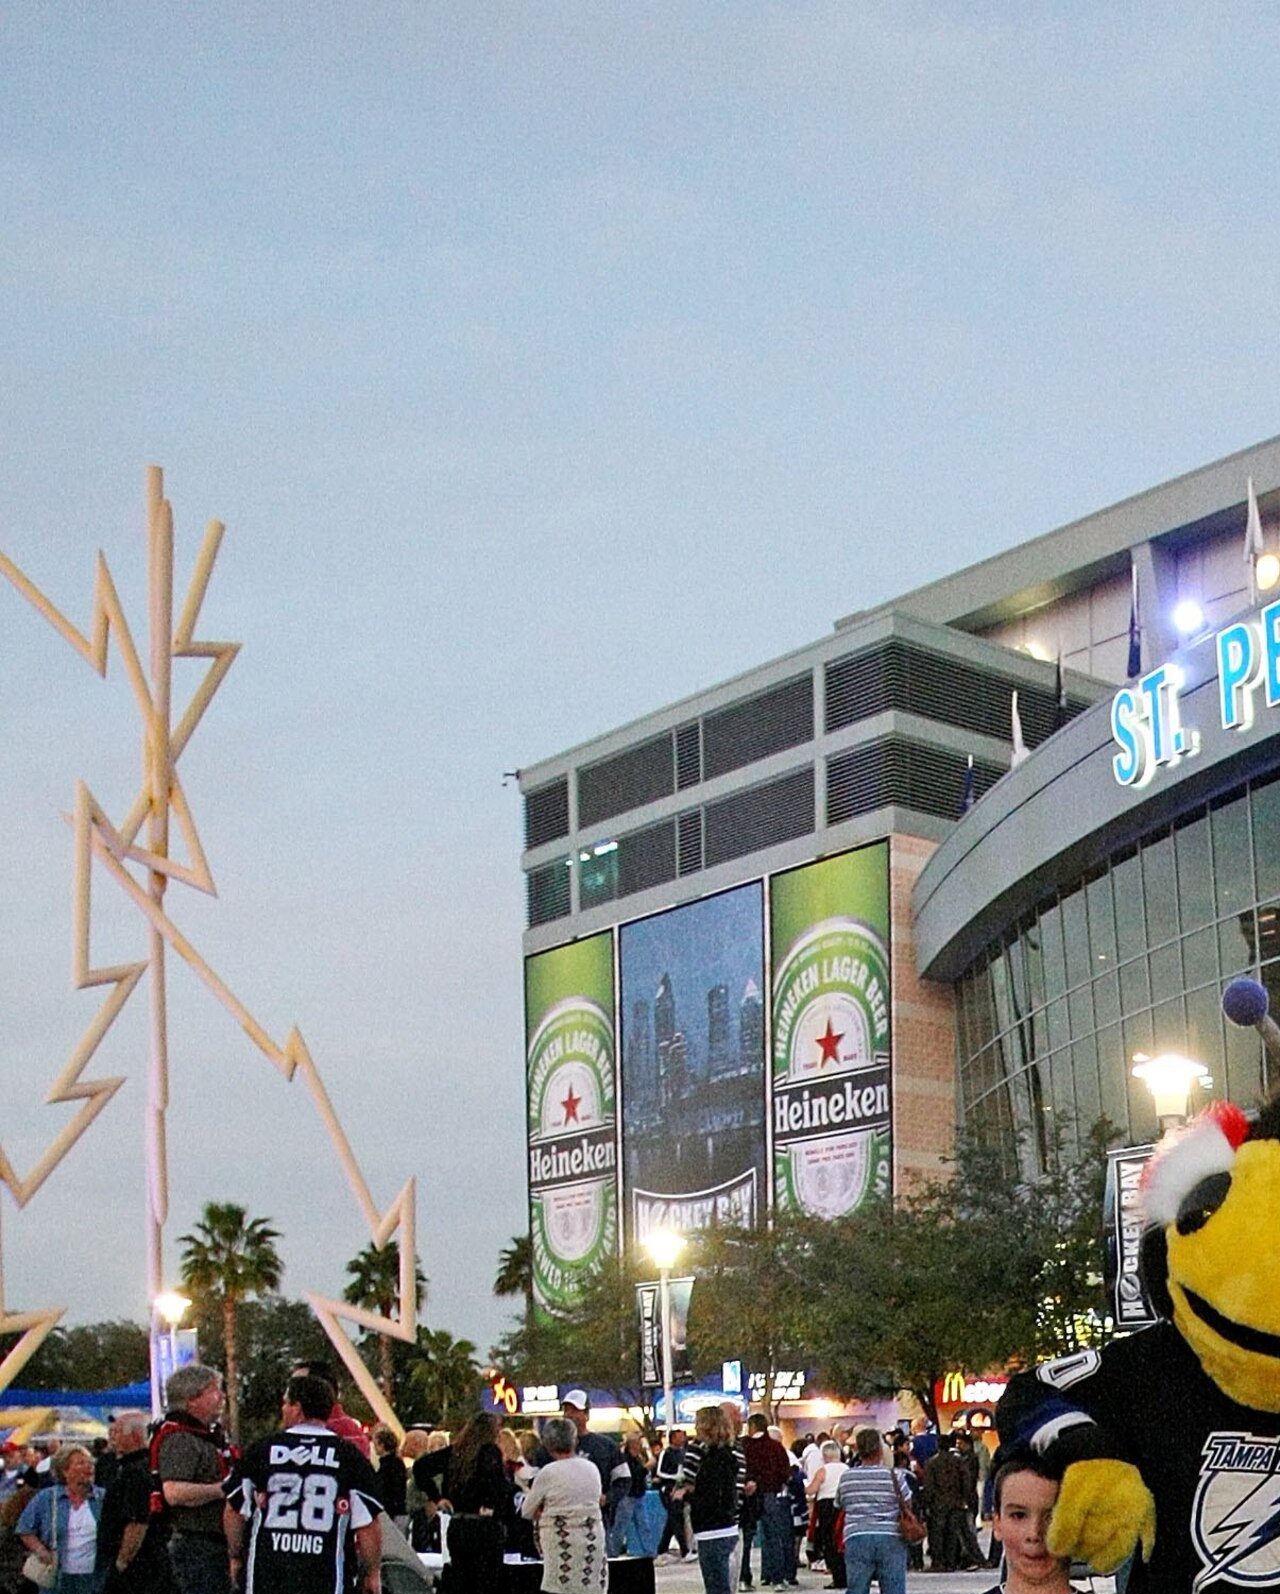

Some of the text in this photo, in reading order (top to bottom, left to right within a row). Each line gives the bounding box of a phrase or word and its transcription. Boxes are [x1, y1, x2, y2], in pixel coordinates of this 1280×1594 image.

[1110, 662, 1191, 786] ST.
[775, 956, 888, 1059] HEINEKEN LAGER BEER
[774, 1081, 890, 1134] Heineken
[530, 1138, 616, 1183] Heineken
[1120, 1206, 1148, 1319] HOCKEY
[269, 1445, 341, 1469] DELL
[1208, 1438, 1278, 1471] TAMPA
[263, 1472, 338, 1533] 28
[271, 1532, 324, 1555] YOUNG
